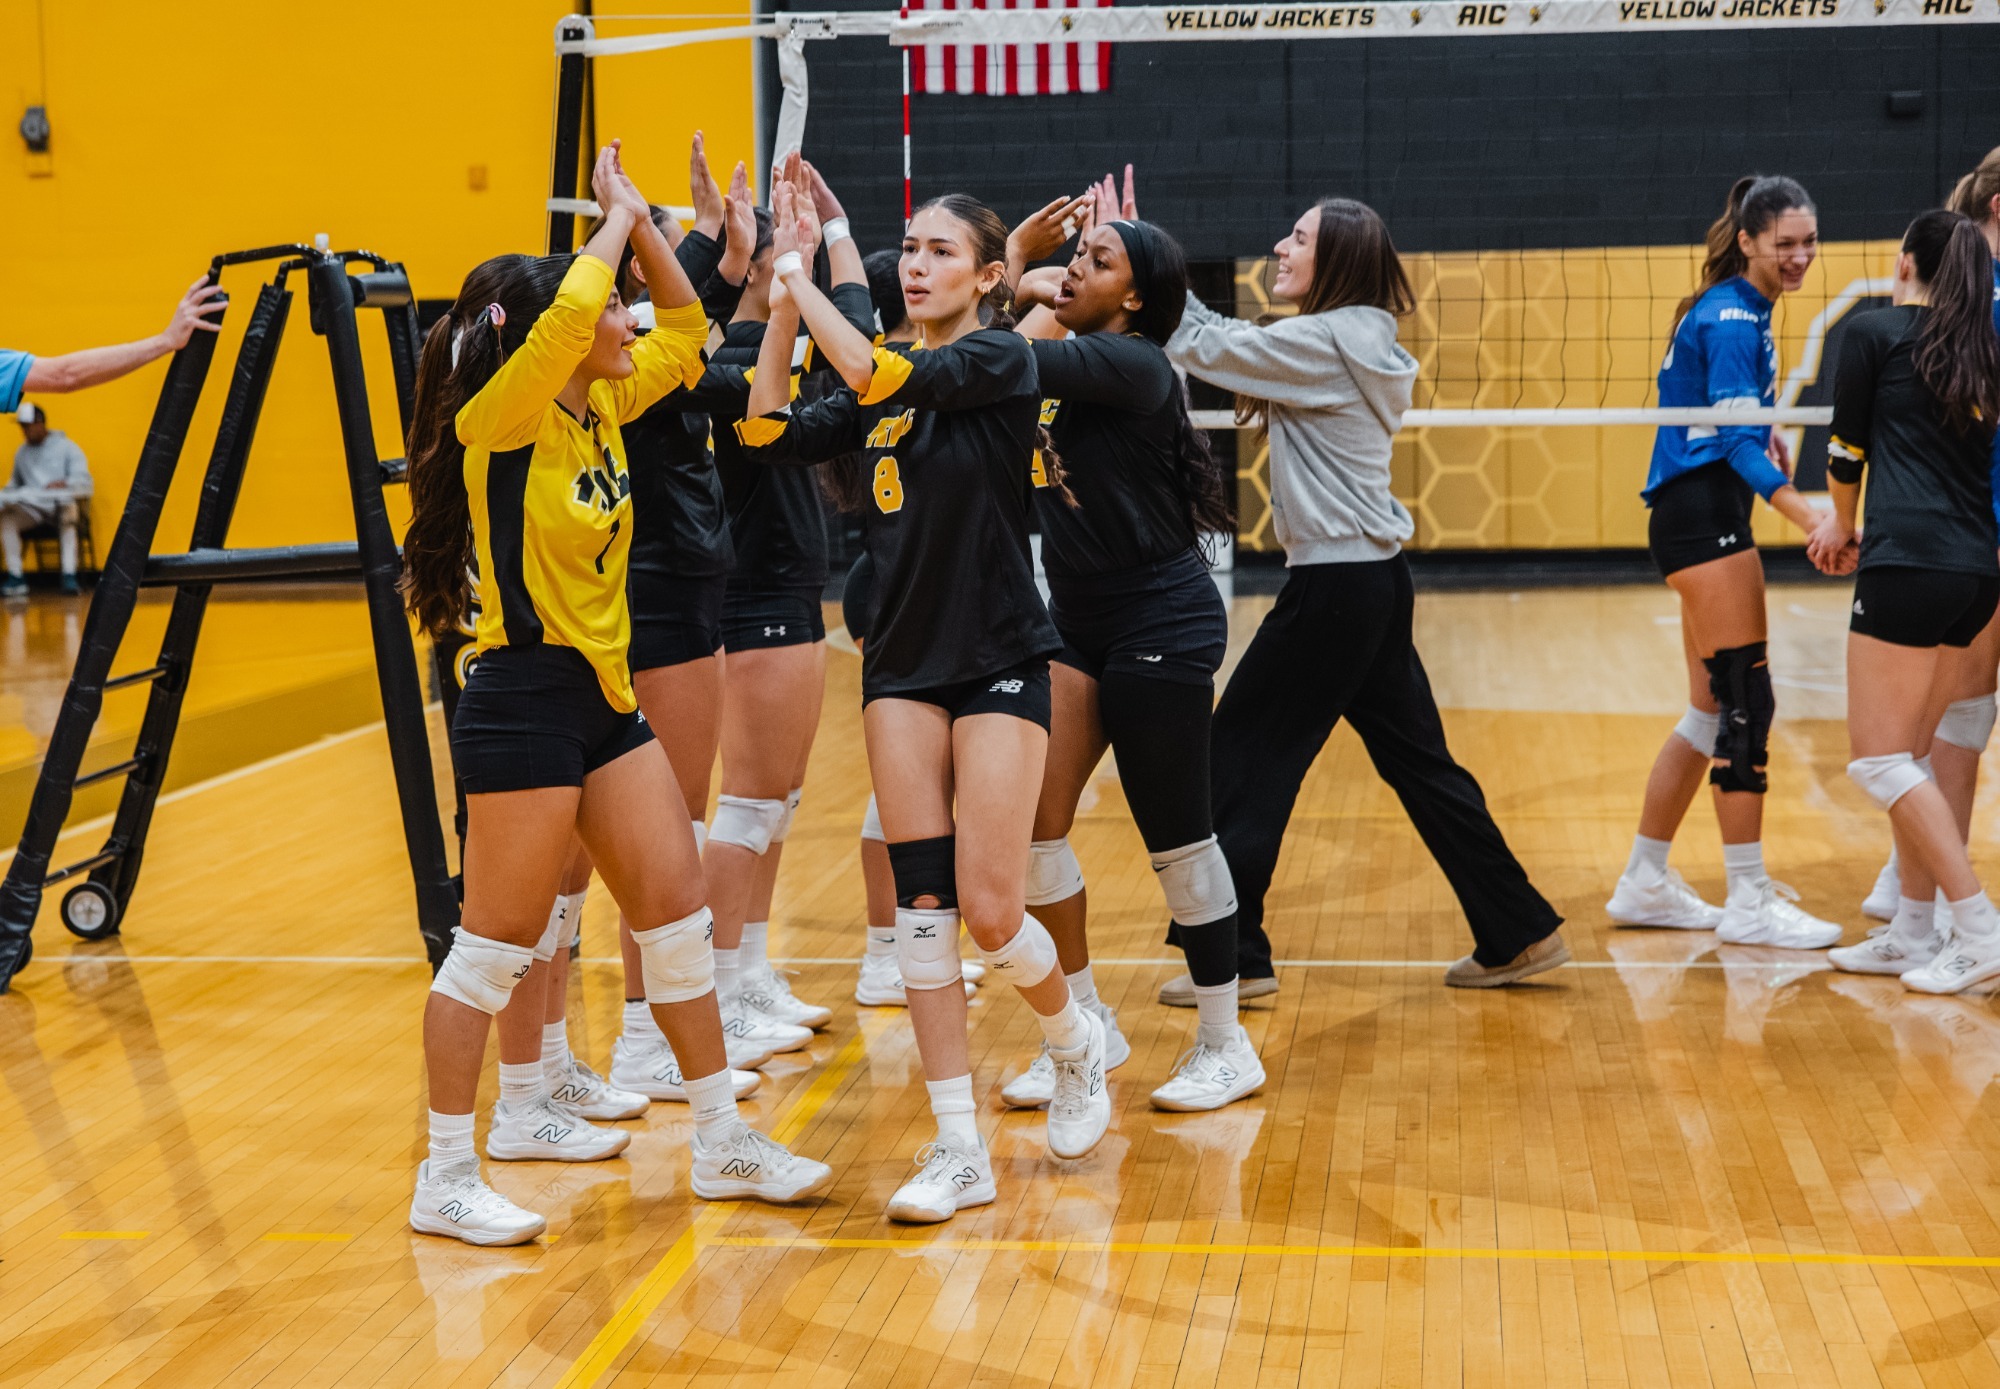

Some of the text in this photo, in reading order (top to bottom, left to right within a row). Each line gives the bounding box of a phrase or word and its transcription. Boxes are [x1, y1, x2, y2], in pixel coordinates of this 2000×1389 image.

[1166, 8, 1375, 29] YELLOW JACKETS
[1458, 5, 1506, 25] AIC
[1620, 0, 1837, 20] YELLOW JACKETS
[873, 455, 904, 514] 8
